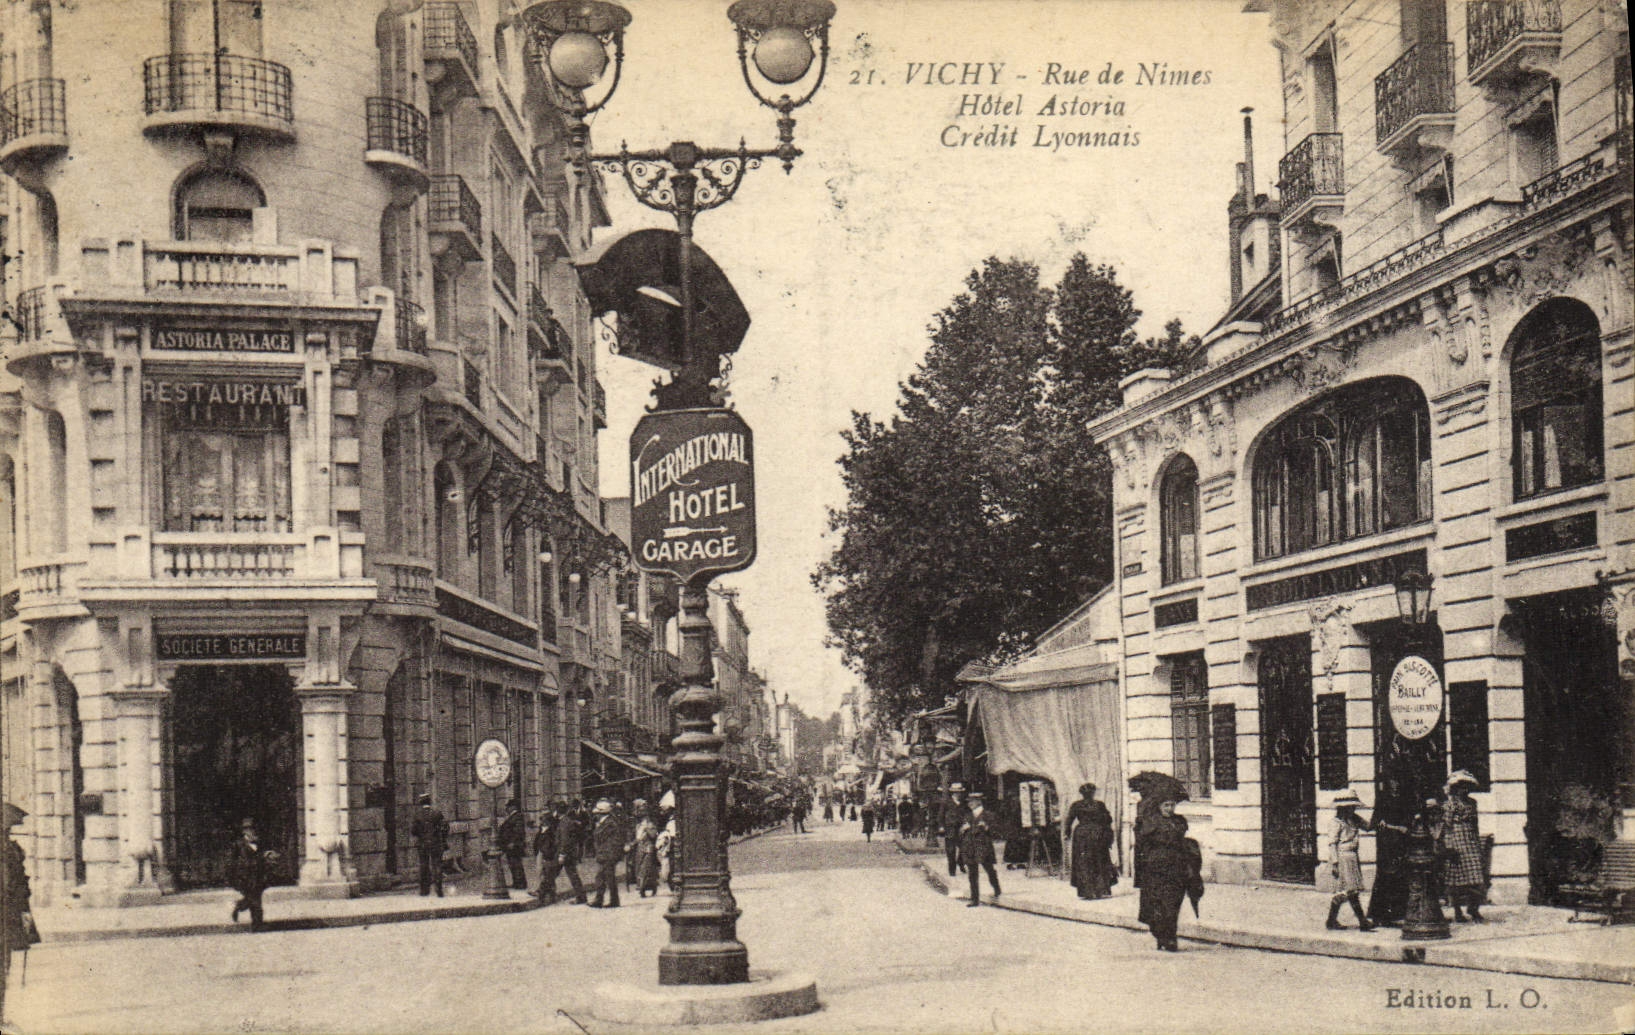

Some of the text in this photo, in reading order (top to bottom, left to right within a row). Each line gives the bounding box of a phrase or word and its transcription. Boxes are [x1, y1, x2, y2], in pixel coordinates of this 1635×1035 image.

[155, 331, 290, 351] ASTORIA PALACE
[142, 379, 304, 405] RESTAURANT
[632, 432, 749, 507] INTERNATIONAL
[669, 483, 745, 523] HOTEL
[642, 535, 739, 562] GARAGE
[229, 637, 300, 654] GENERALE
[1403, 660, 1438, 687] BISCOTTE
[1397, 684, 1426, 698] BAILLY
